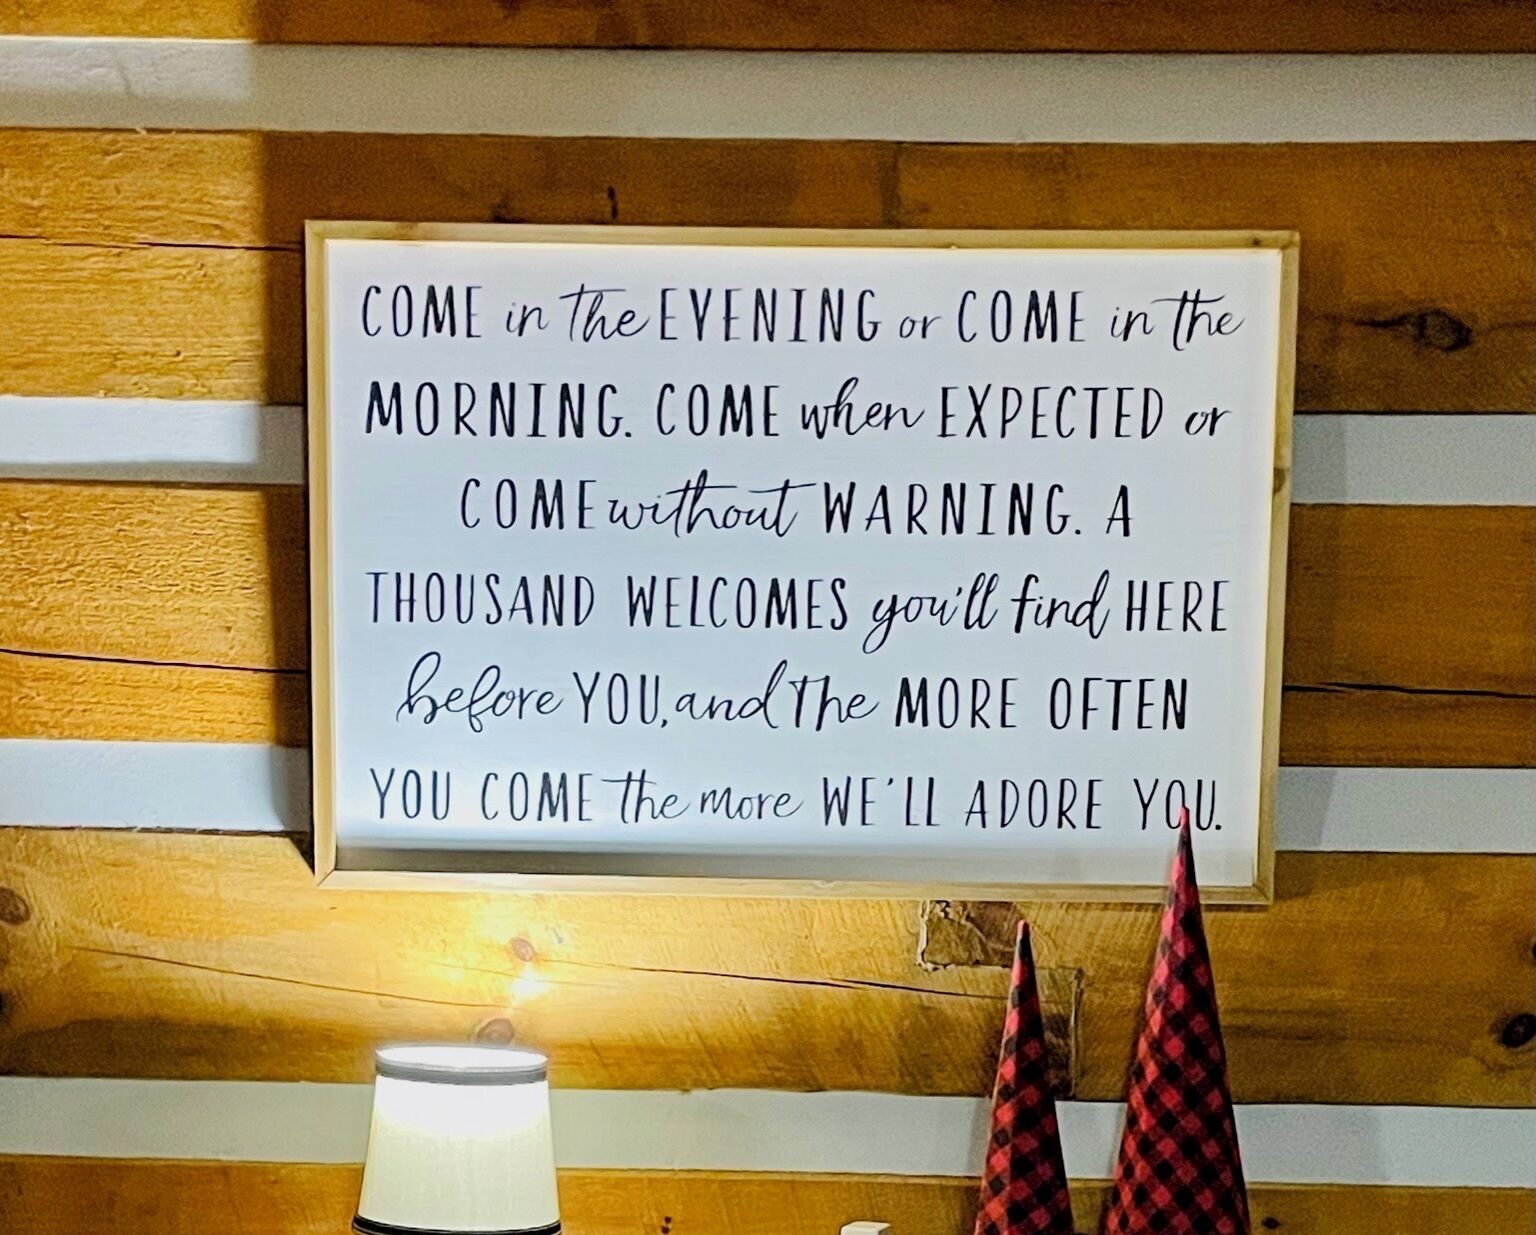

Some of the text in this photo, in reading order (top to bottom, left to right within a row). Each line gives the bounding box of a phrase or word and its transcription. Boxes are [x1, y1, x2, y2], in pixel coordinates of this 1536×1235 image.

[361, 284, 483, 339] COME
[505, 300, 550, 338] in
[660, 286, 882, 343] EVENING
[899, 314, 942, 340] or
[957, 289, 1085, 343] COME
[1109, 304, 1155, 342] in
[1151, 288, 1245, 352] the
[365, 376, 1232, 440] MORNING. COME when EXPECTED or
[460, 468, 1133, 538] COME without WARNING. A
[365, 569, 1231, 655] THOUSAND WELCOMES you'll find HERE
[396, 651, 564, 733] before
[894, 676, 1018, 729] MORE
[1049, 677, 1188, 731] OFTEN
[369, 767, 1222, 832] YOU COME the more WE'LL ADORE YOU.
